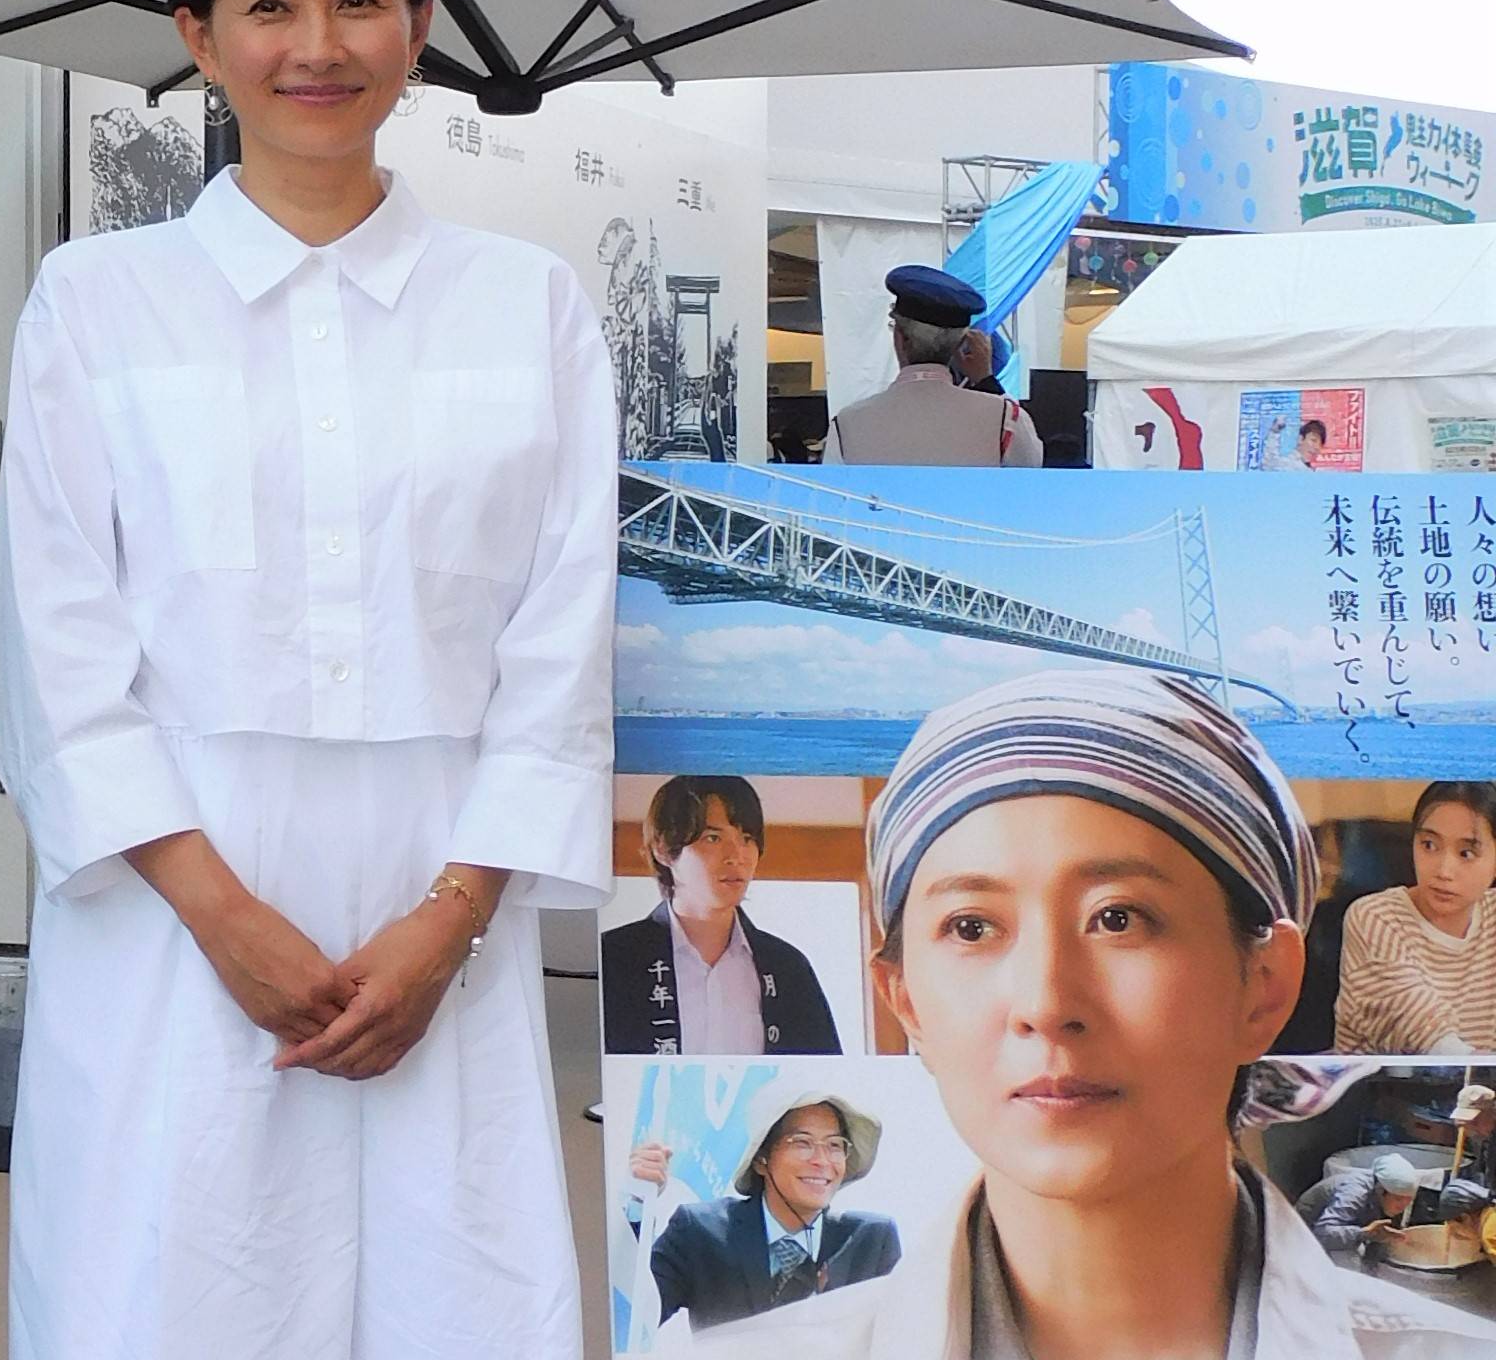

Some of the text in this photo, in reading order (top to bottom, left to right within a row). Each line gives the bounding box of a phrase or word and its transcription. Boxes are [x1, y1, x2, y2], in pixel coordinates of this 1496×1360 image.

[446, 114, 483, 158] 徳島
[574, 147, 605, 187] 福井
[1293, 105, 1483, 187] 滋賀 魅力体験
[1406, 151, 1481, 201] ウィーク
[1370, 494, 1416, 729] 伝統を重んじて、
[1419, 495, 1460, 666] 土地の願い。
[1321, 494, 1370, 764] 未来へ繋いでいく。
